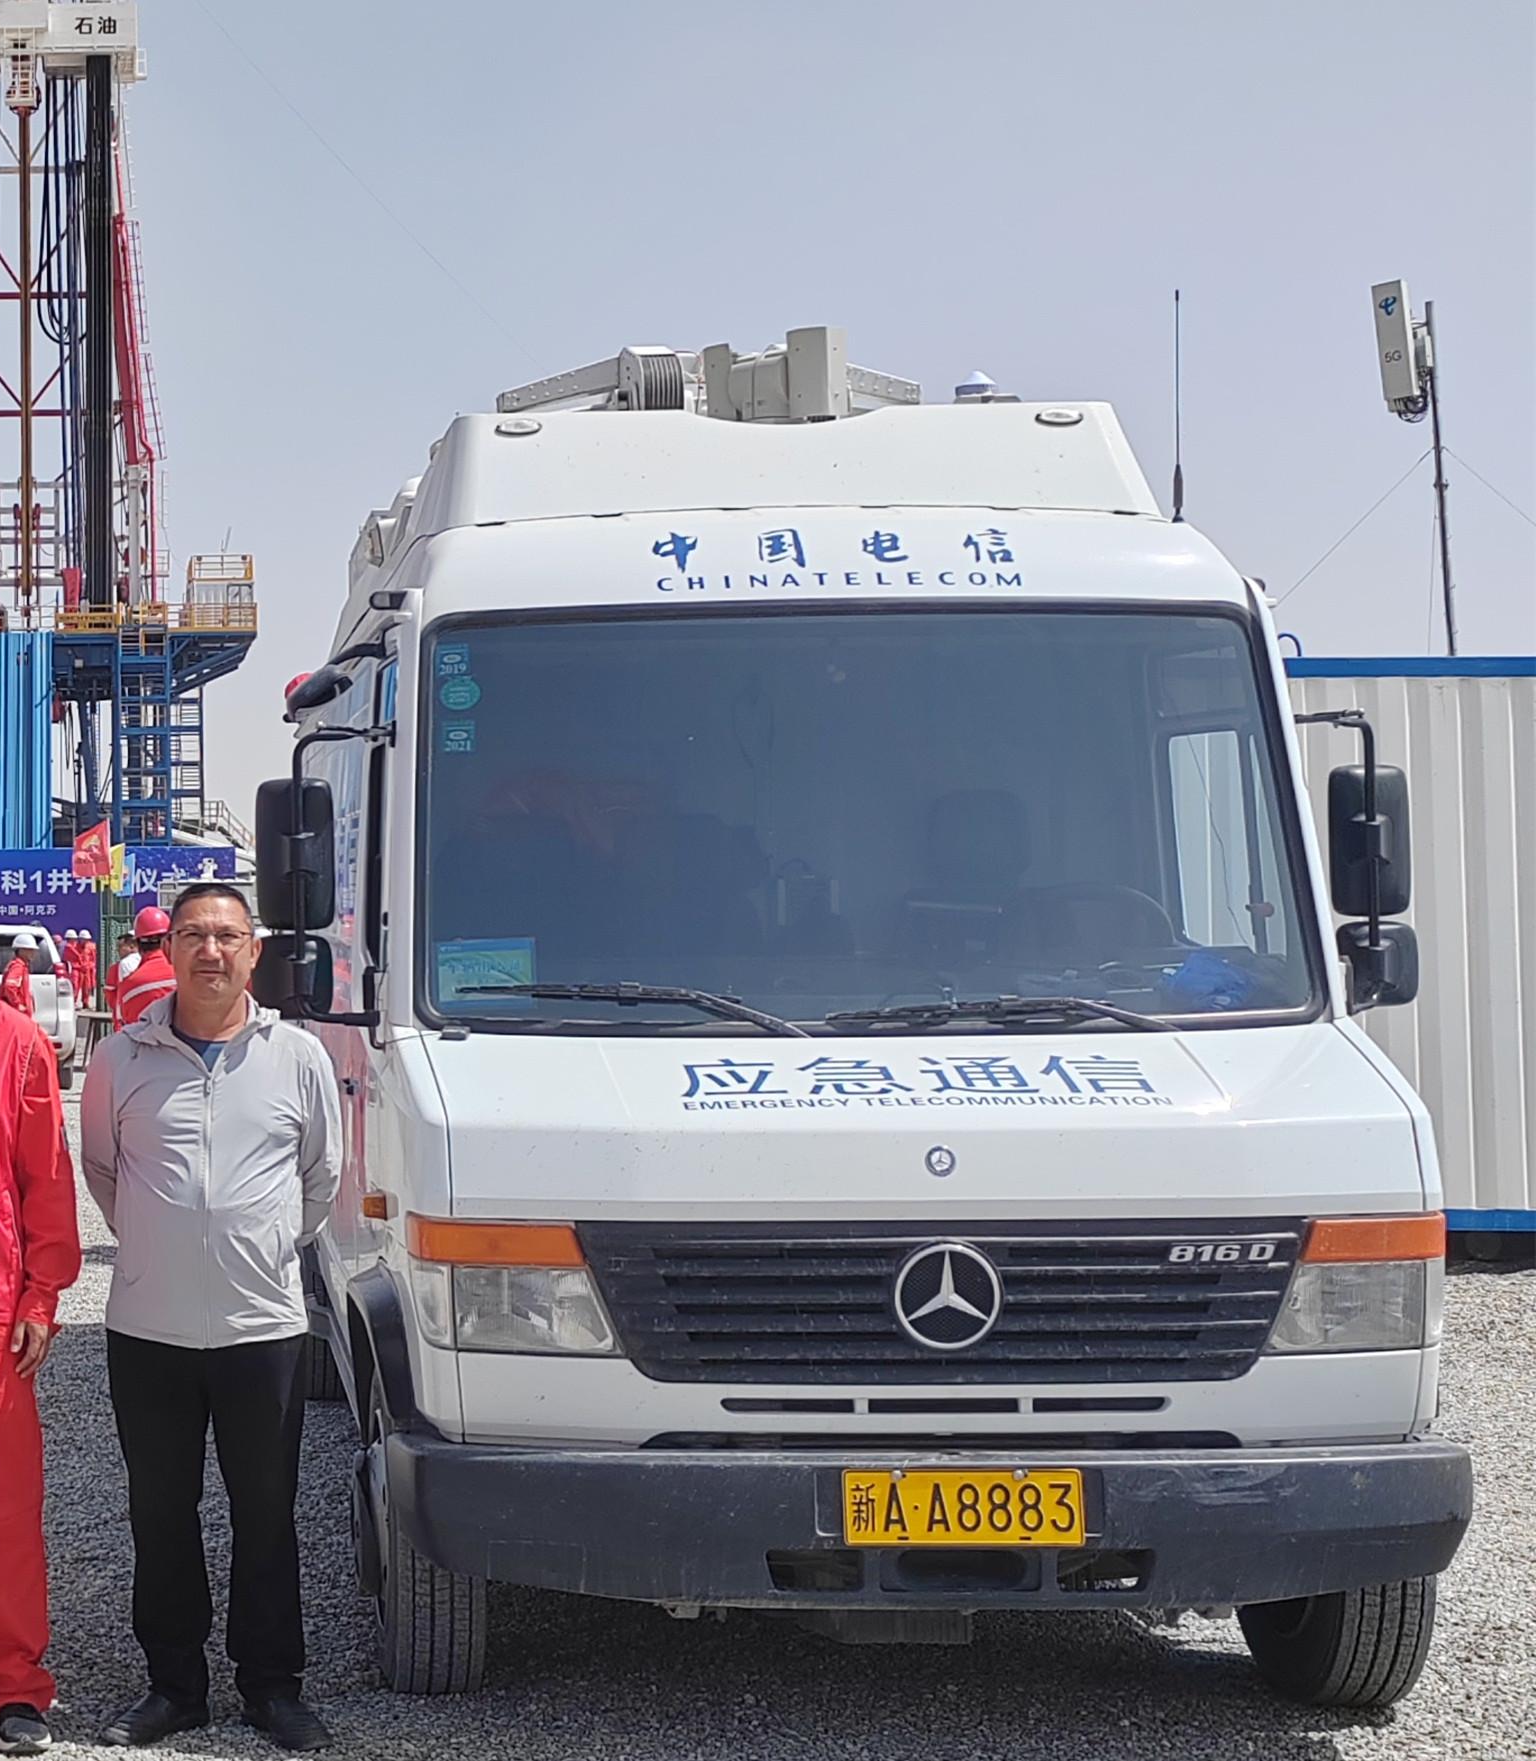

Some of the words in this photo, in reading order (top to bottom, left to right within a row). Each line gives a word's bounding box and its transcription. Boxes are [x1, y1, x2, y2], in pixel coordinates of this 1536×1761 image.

[74, 17, 117, 35] 石油
[1385, 350, 1402, 363] 5G
[652, 529, 1015, 573] 中国电信
[439, 664, 466, 676] 2019
[445, 740, 471, 752] 2021
[680, 1055, 1157, 1098] 应急通信
[682, 1097, 849, 1111] EMERGENCY
[864, 1096, 1173, 1108] TELECOMMUNICATION
[1169, 1244, 1241, 1263] 816
[1248, 1243, 1275, 1261] D
